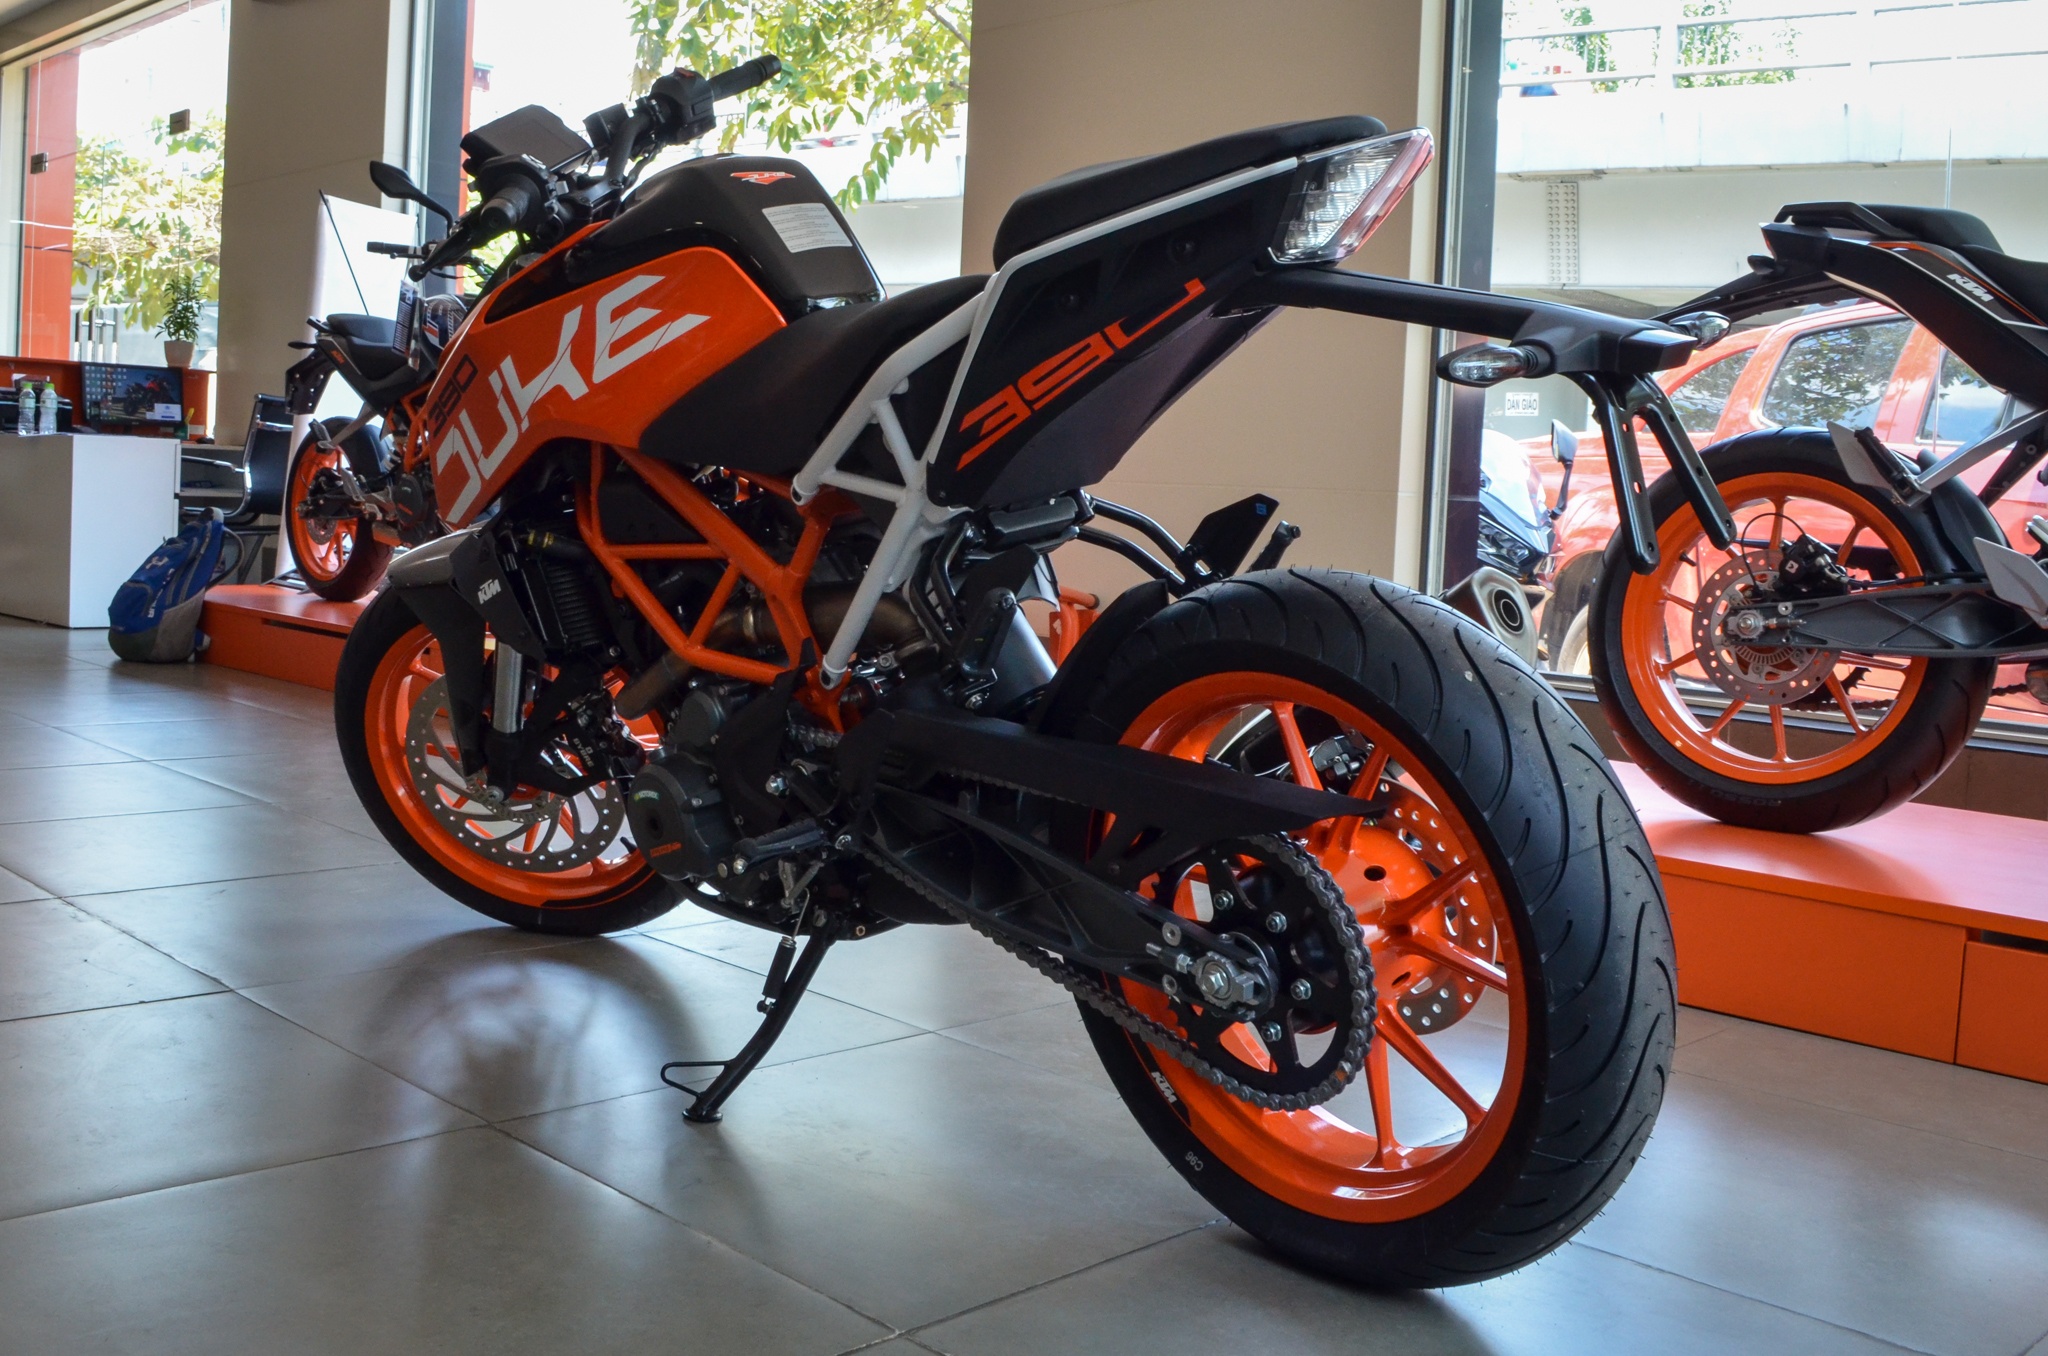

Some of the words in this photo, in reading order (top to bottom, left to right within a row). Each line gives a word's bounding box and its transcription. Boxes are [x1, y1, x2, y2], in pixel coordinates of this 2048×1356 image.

[1946, 273, 1994, 302] KTM
[427, 354, 478, 438] 390
[436, 275, 712, 524] DUKE
[478, 579, 501, 605] KTM
[1151, 1071, 1177, 1104] KTM
[1185, 1151, 1204, 1171] C96
